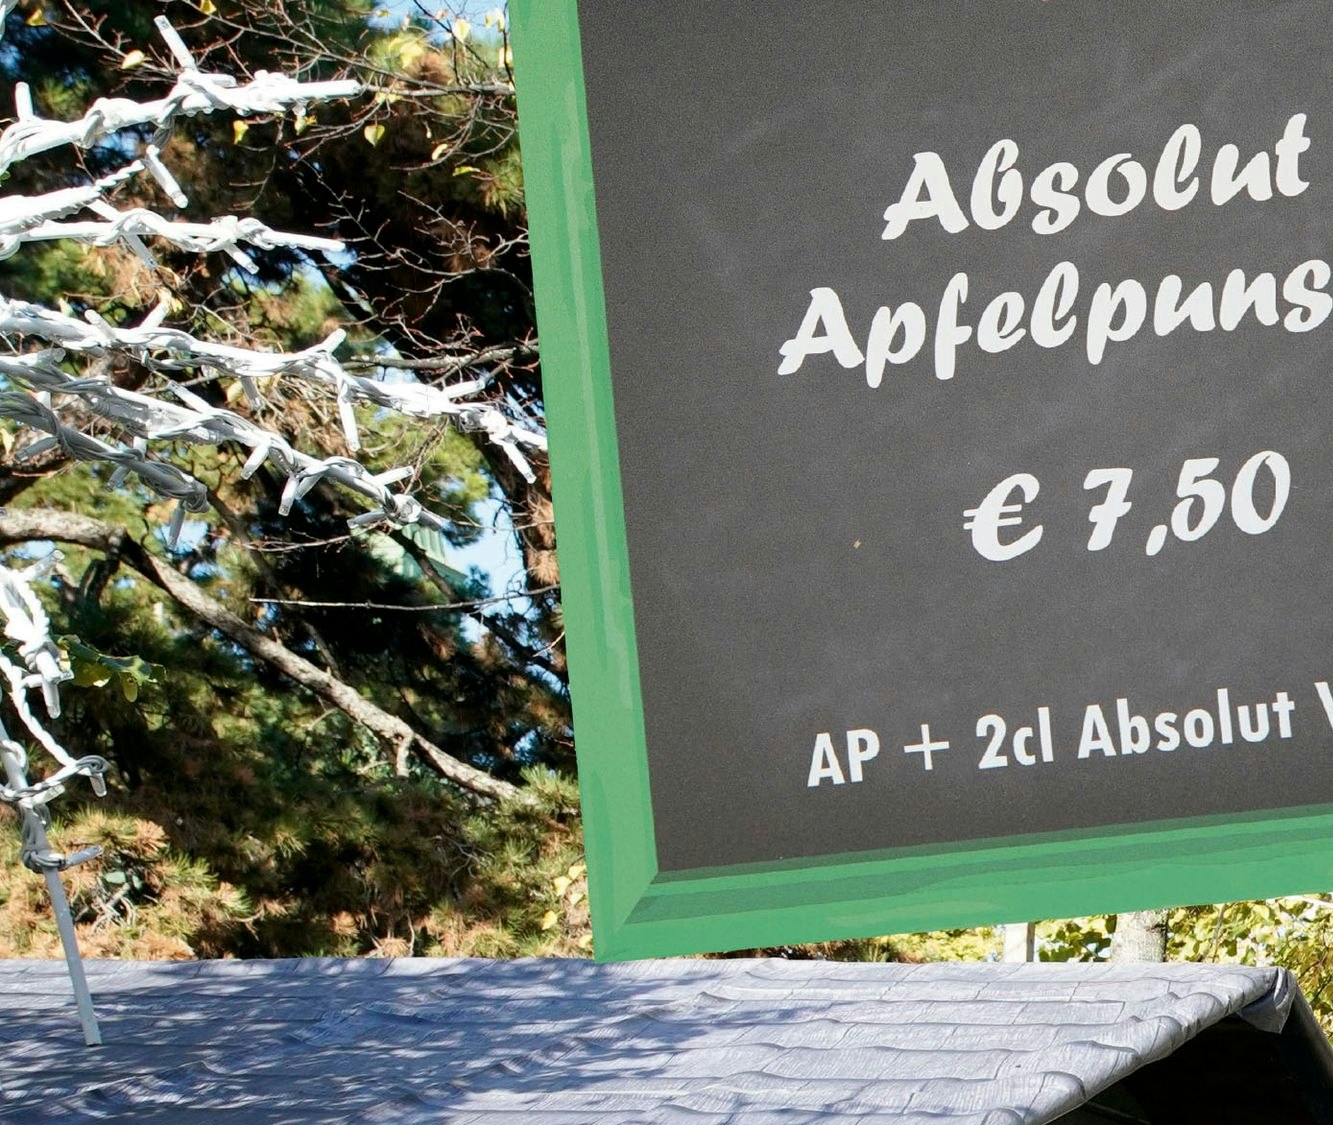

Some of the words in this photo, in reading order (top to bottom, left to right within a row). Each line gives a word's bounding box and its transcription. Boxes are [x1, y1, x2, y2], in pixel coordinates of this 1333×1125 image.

[880, 112, 1312, 241] Absolut
[962, 472, 1044, 562] €
[1082, 450, 1292, 557] 7,50
[807, 728, 881, 788] AP
[903, 723, 950, 771] +
[975, 706, 1055, 770] 2cl
[1077, 687, 1296, 760] Absolut
